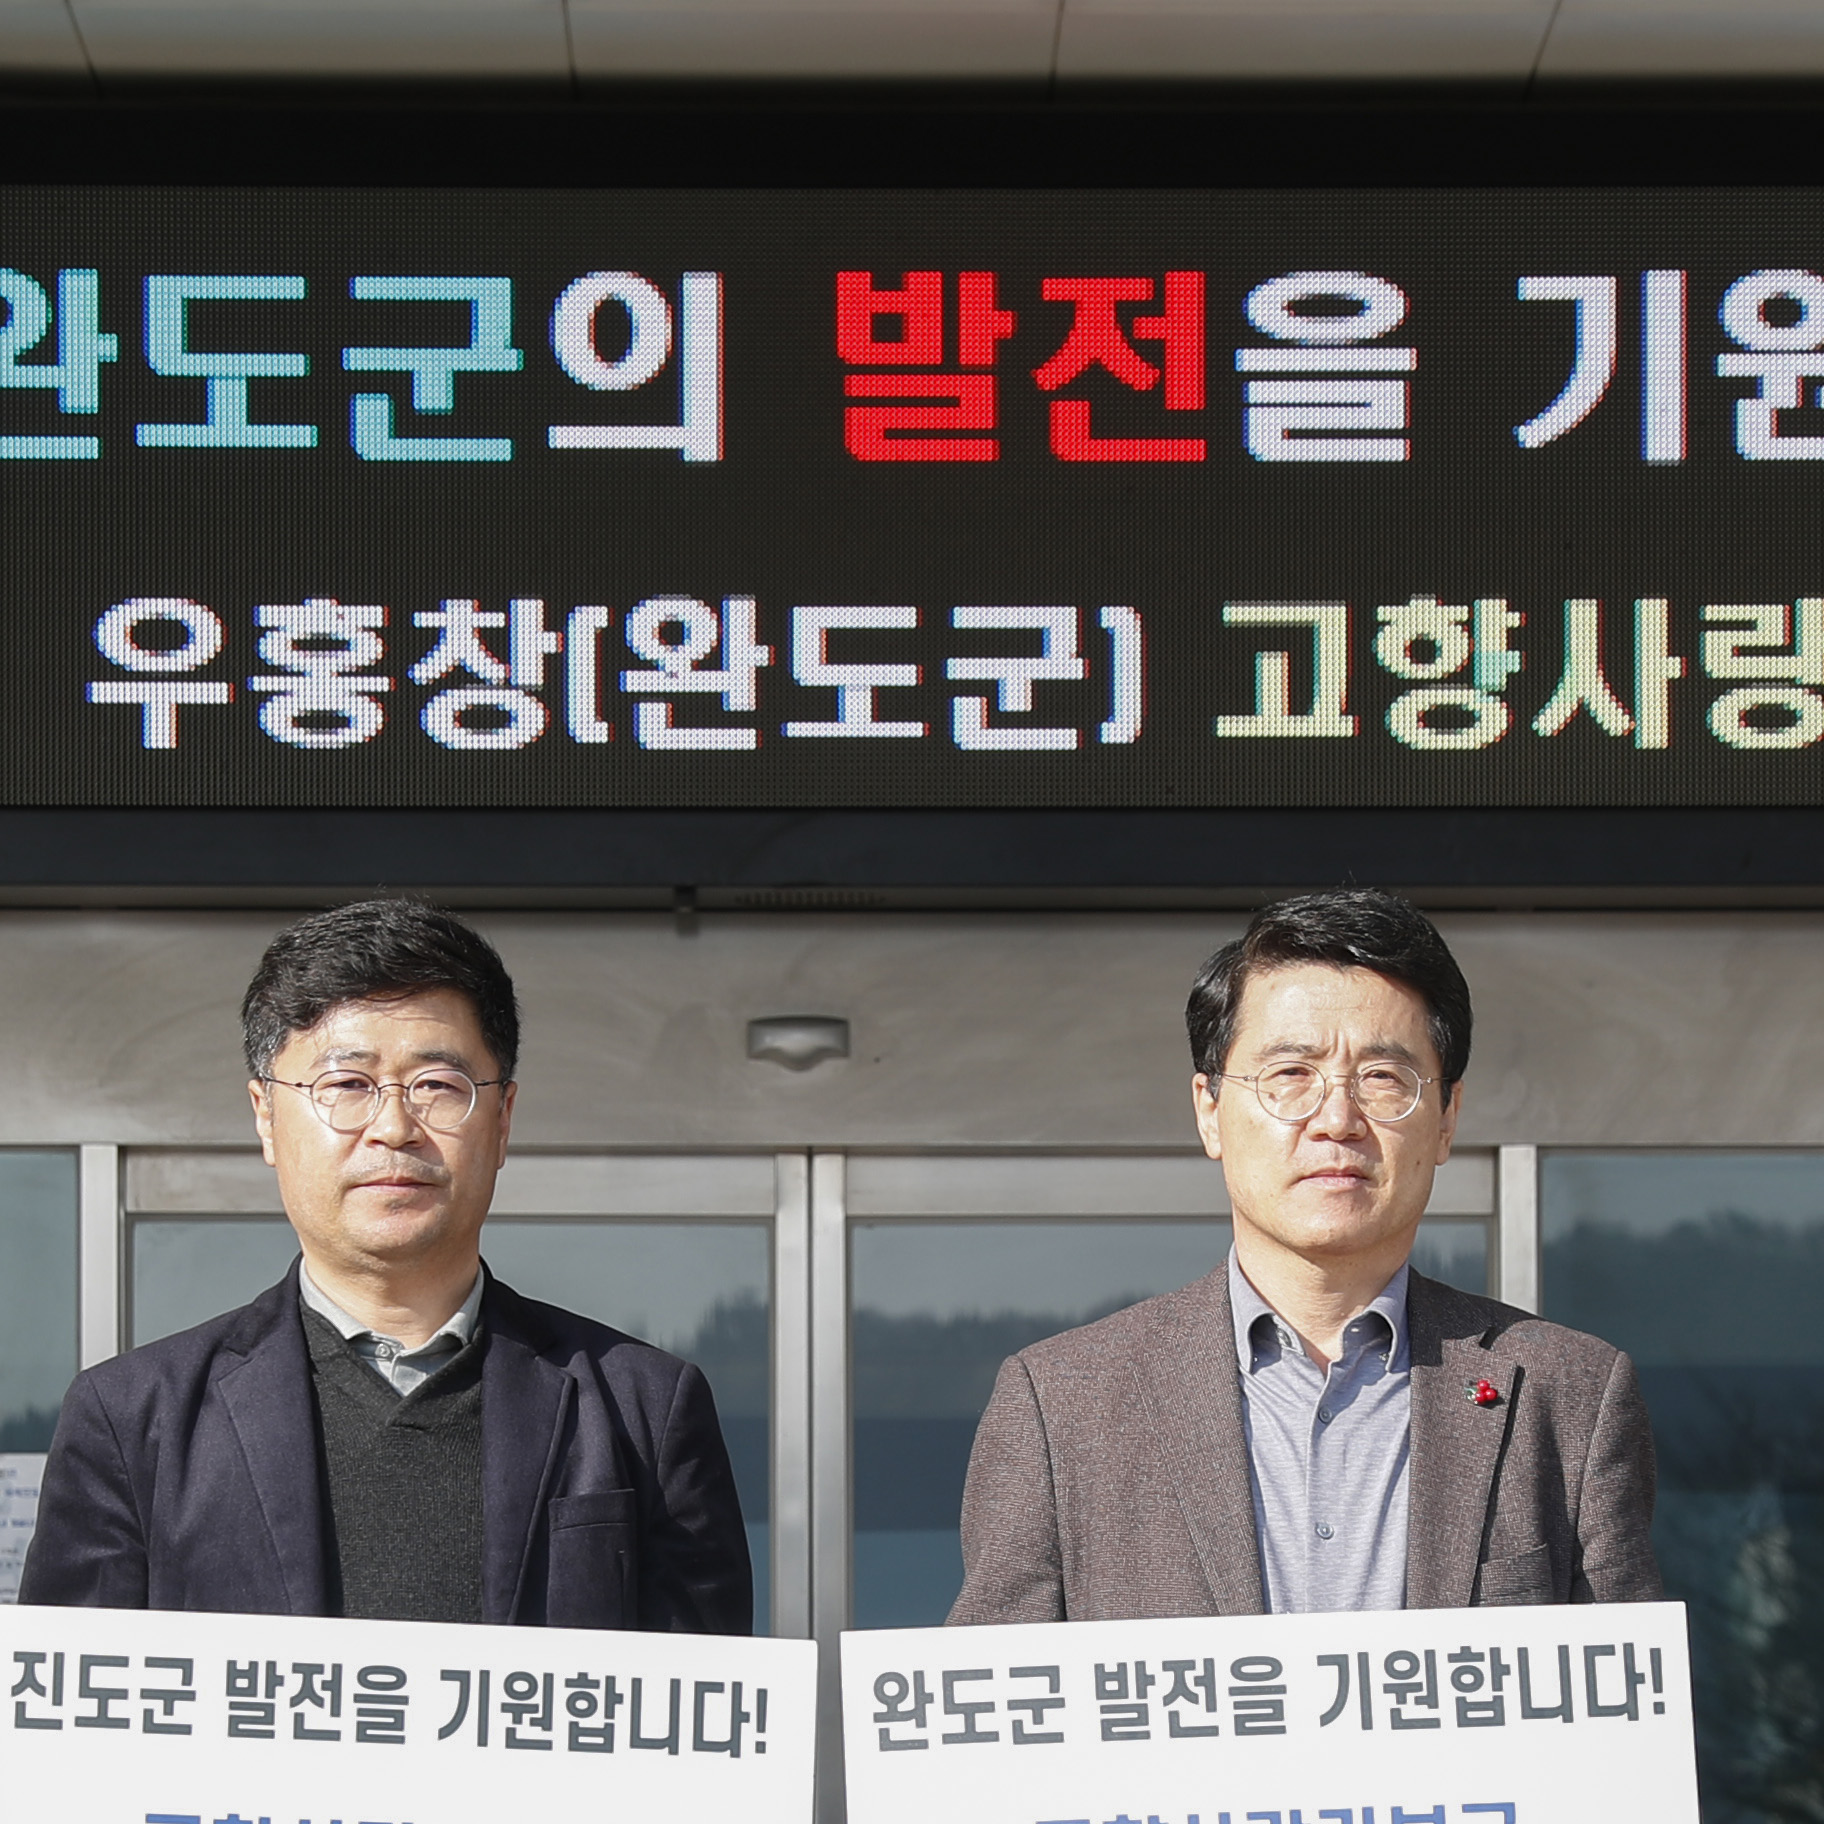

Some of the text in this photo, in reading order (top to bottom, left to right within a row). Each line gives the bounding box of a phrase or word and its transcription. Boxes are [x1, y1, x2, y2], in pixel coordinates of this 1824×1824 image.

[835, 270, 1418, 463] 발전을
[84, 594, 1143, 752] 우홍창(완도군)
[10, 1650, 768, 1759] 진도군 발전을 기원합니다!
[872, 1642, 1666, 1752] 완도군 발전을 기원합니다!
